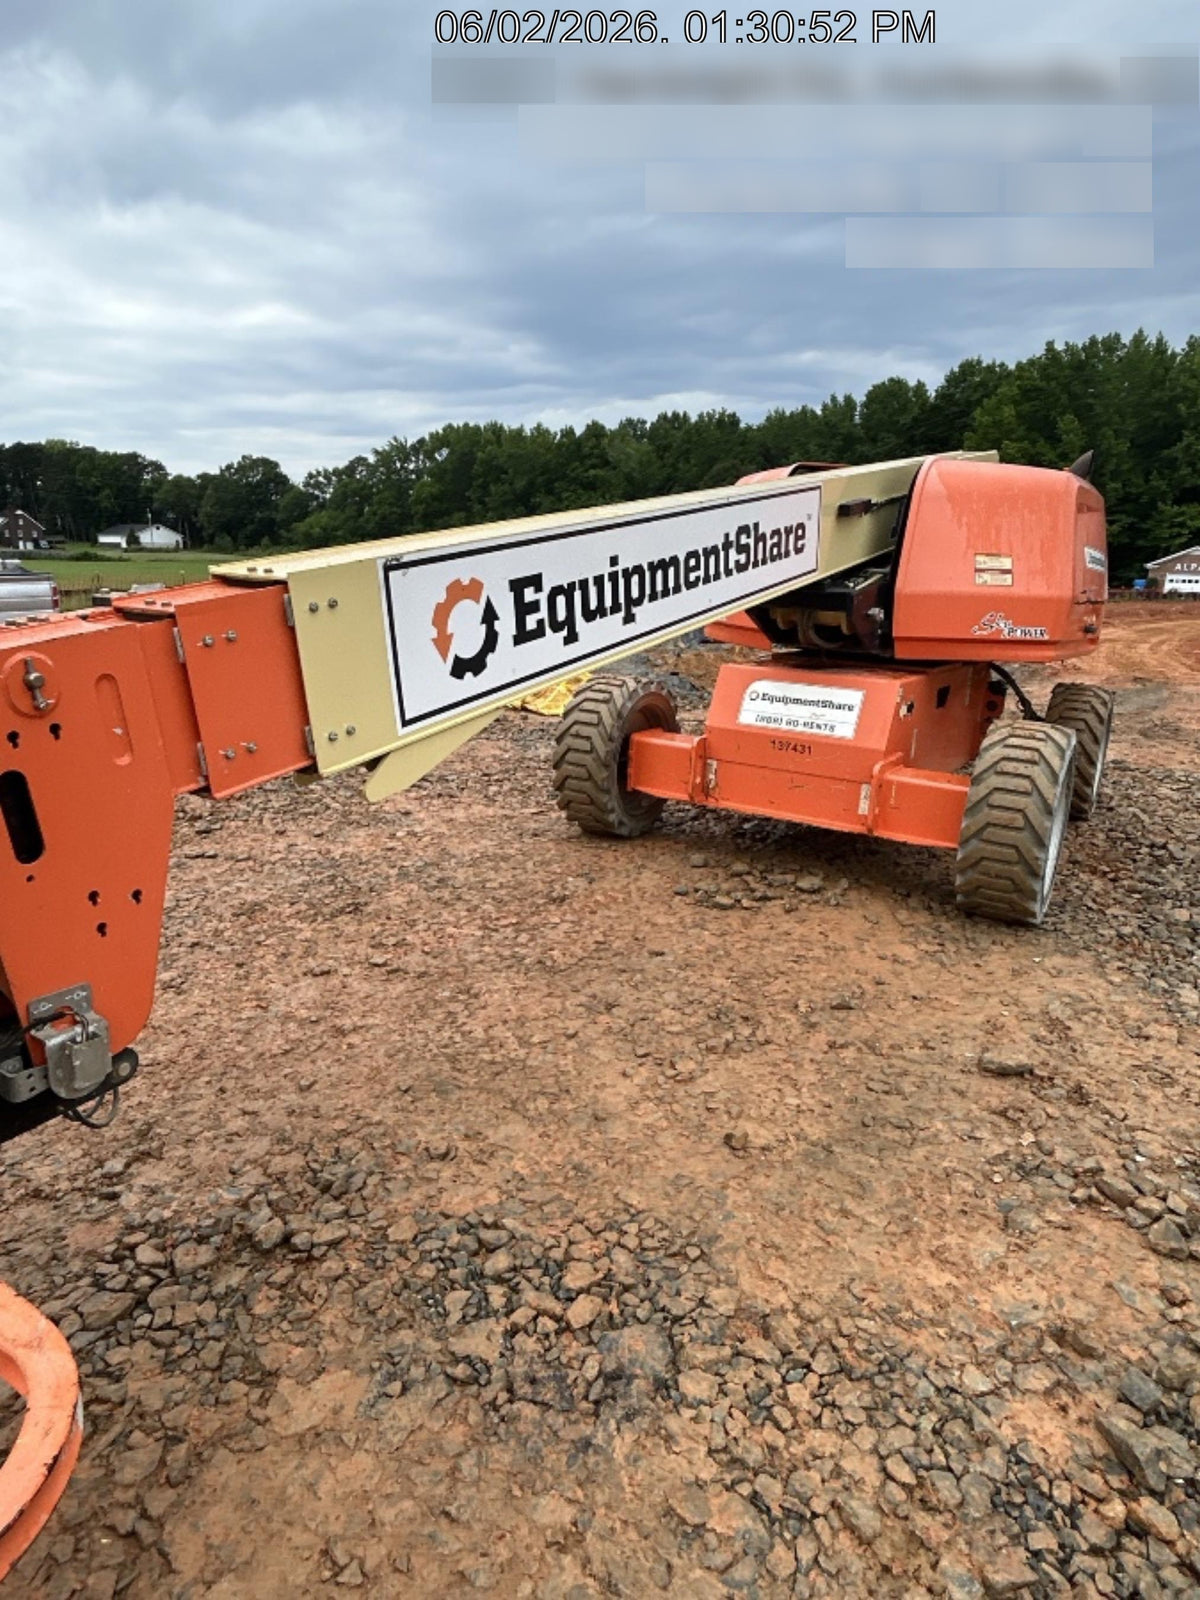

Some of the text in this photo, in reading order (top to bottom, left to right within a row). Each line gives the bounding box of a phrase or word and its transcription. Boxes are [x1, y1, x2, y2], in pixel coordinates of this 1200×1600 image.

[1175, 563, 1200, 571] ALP
[508, 520, 806, 646] EquipmentShare
[760, 692, 855, 712] EquipmentShare
[770, 739, 812, 755] 137431
